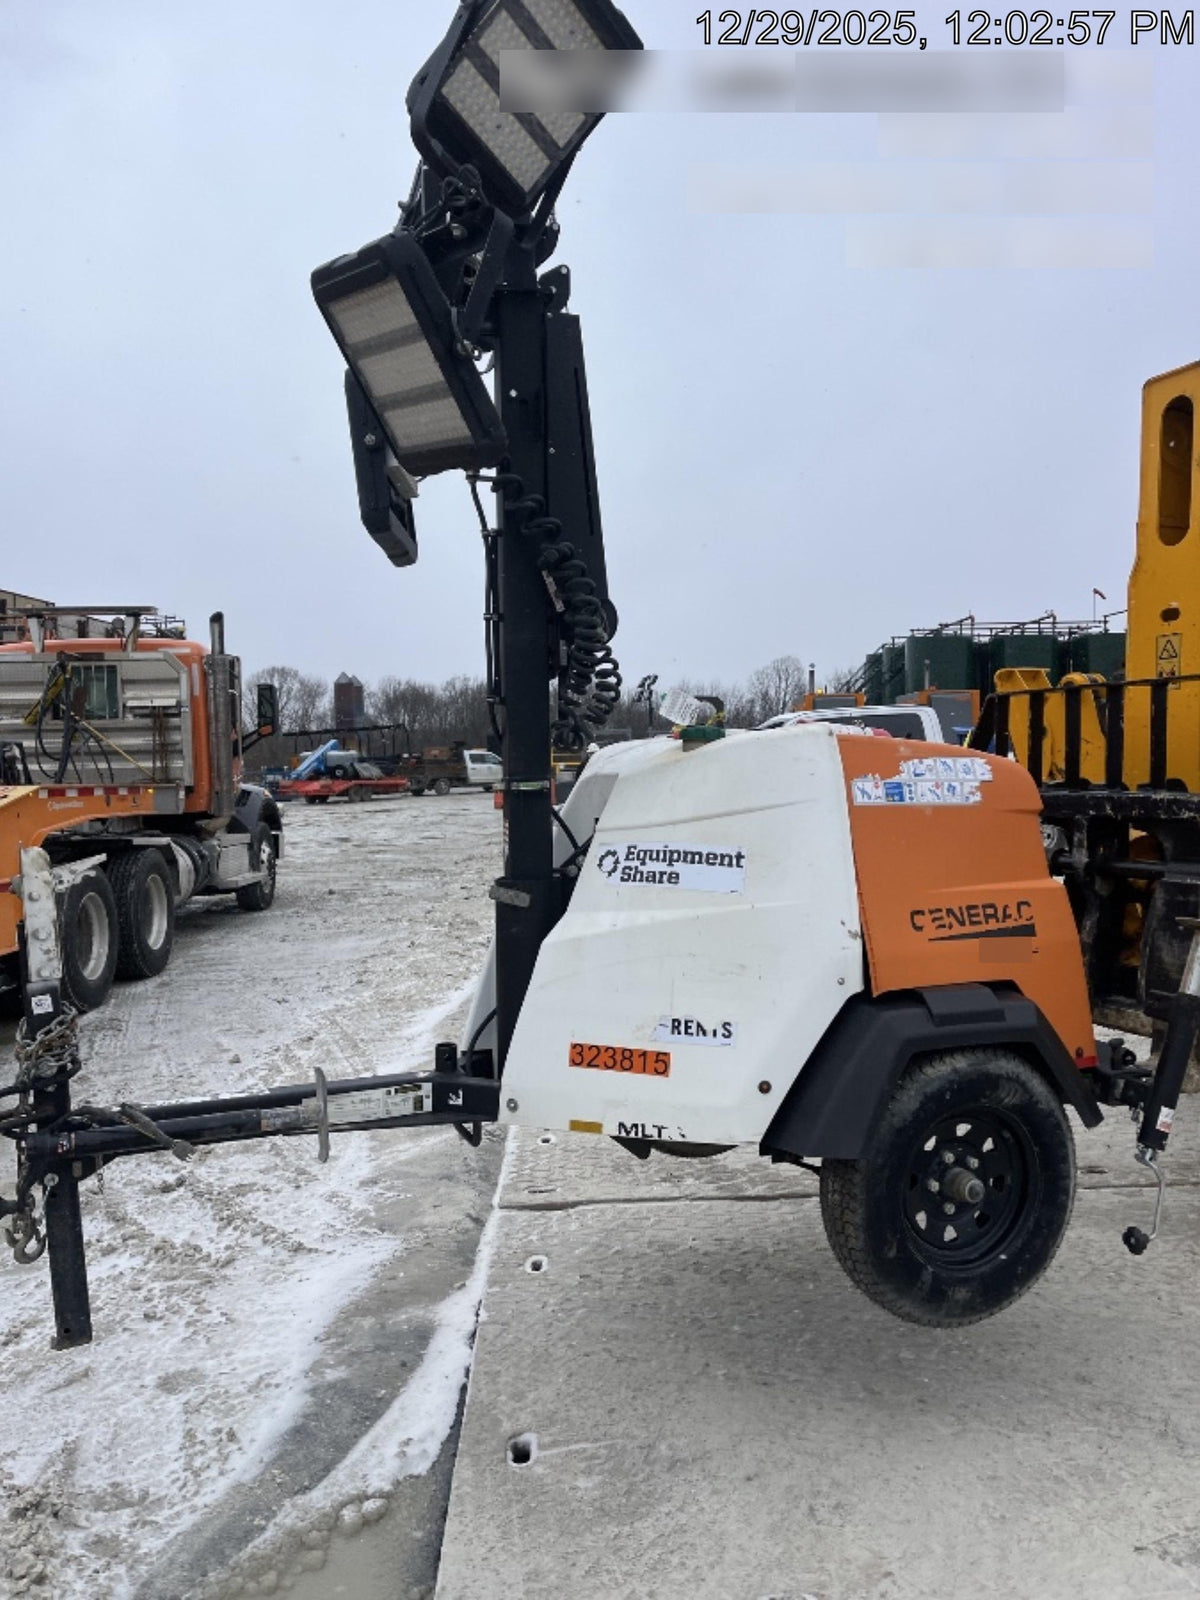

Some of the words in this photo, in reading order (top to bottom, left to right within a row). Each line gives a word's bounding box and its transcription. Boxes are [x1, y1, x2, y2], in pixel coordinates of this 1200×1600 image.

[623, 844, 746, 869] Equipment
[620, 865, 680, 885] Share
[571, 1043, 669, 1076] 323815
